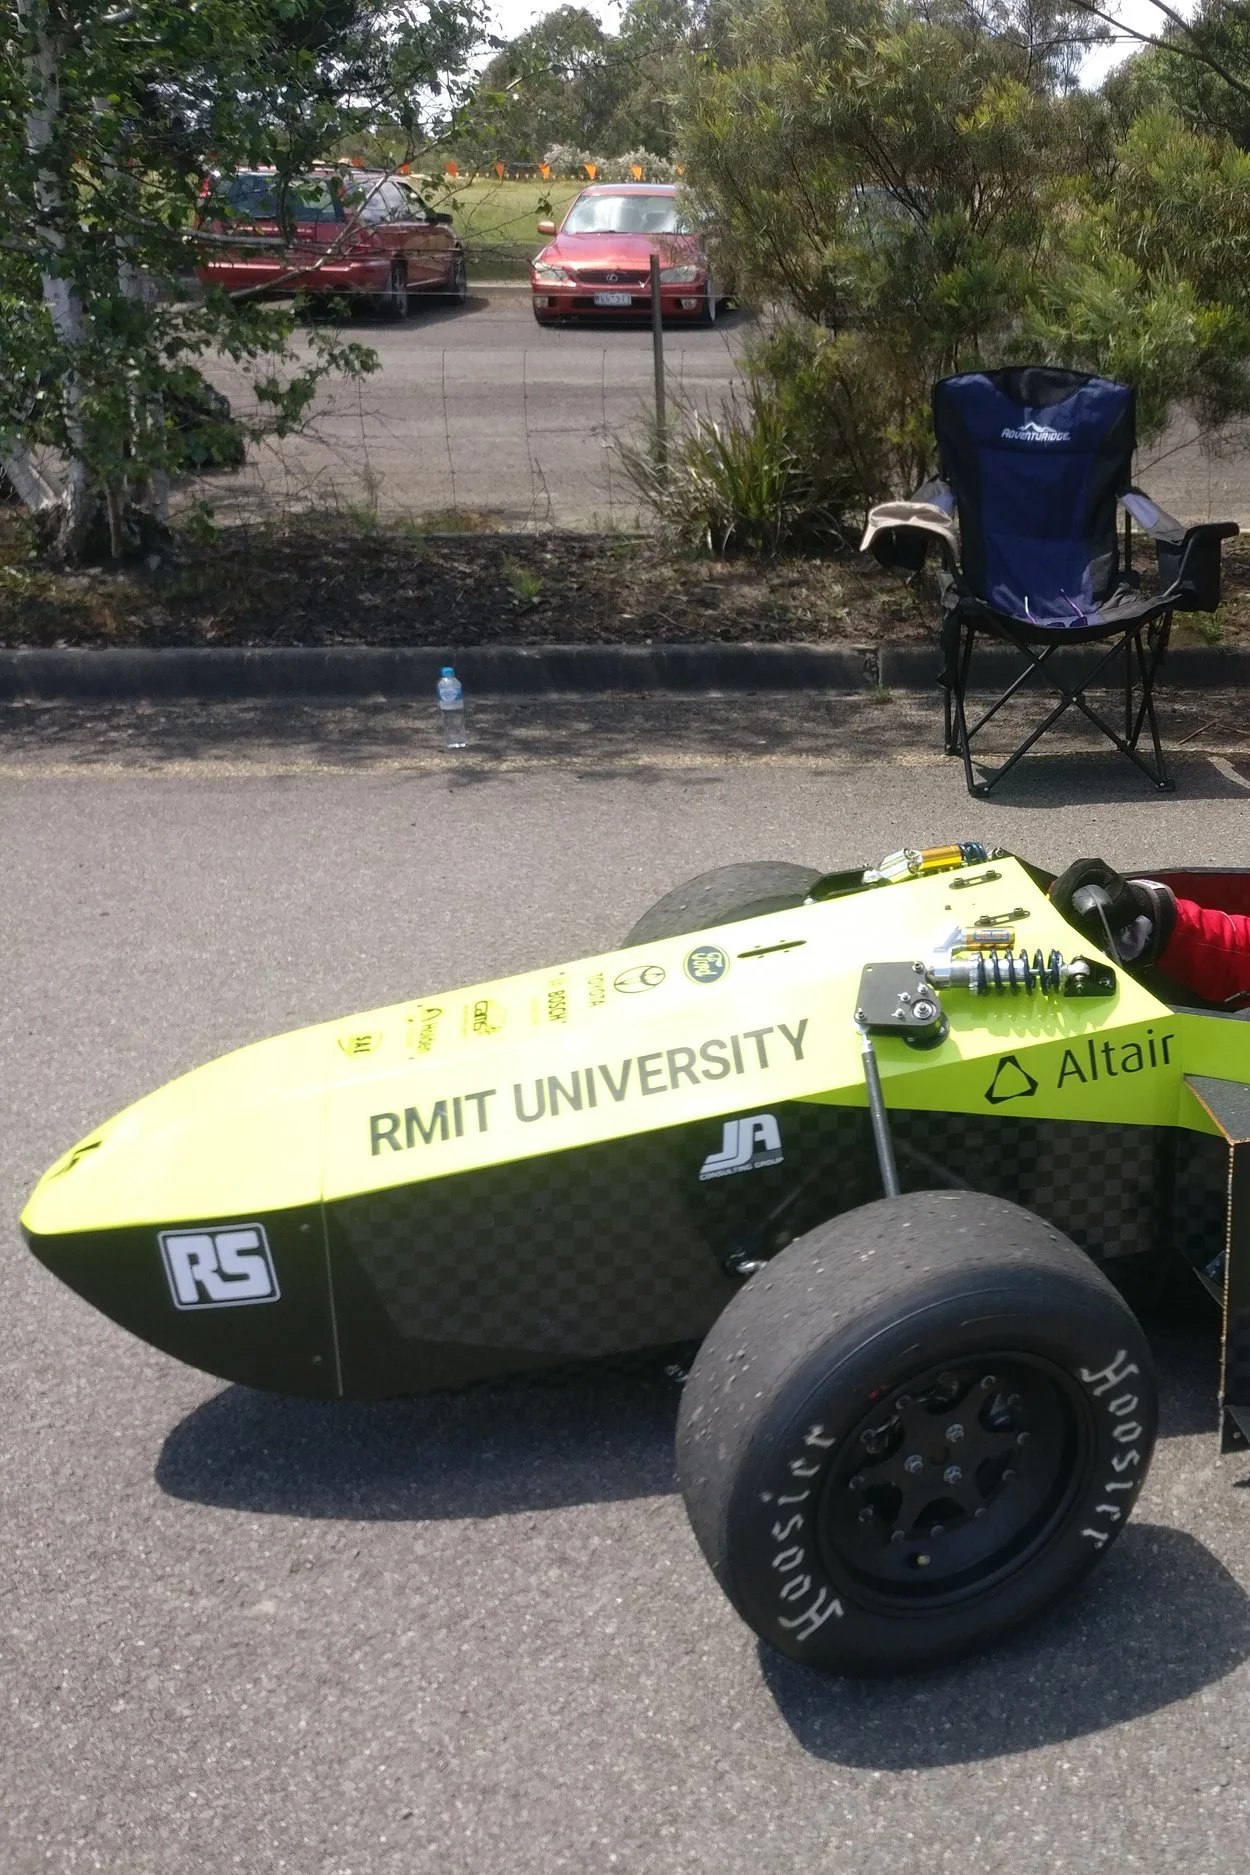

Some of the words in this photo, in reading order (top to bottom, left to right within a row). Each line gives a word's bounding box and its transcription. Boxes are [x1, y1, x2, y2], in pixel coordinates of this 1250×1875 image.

[691, 952, 723, 977] Ford
[548, 989, 567, 1021] BOSCH
[369, 1089, 497, 1156] RMIT
[513, 1018, 809, 1123] UNIVERSITY
[1056, 1028, 1175, 1089] Altair
[700, 1114, 782, 1174] JA
[166, 1230, 271, 1304] RS
[757, 1423, 844, 1641] Hoosier
